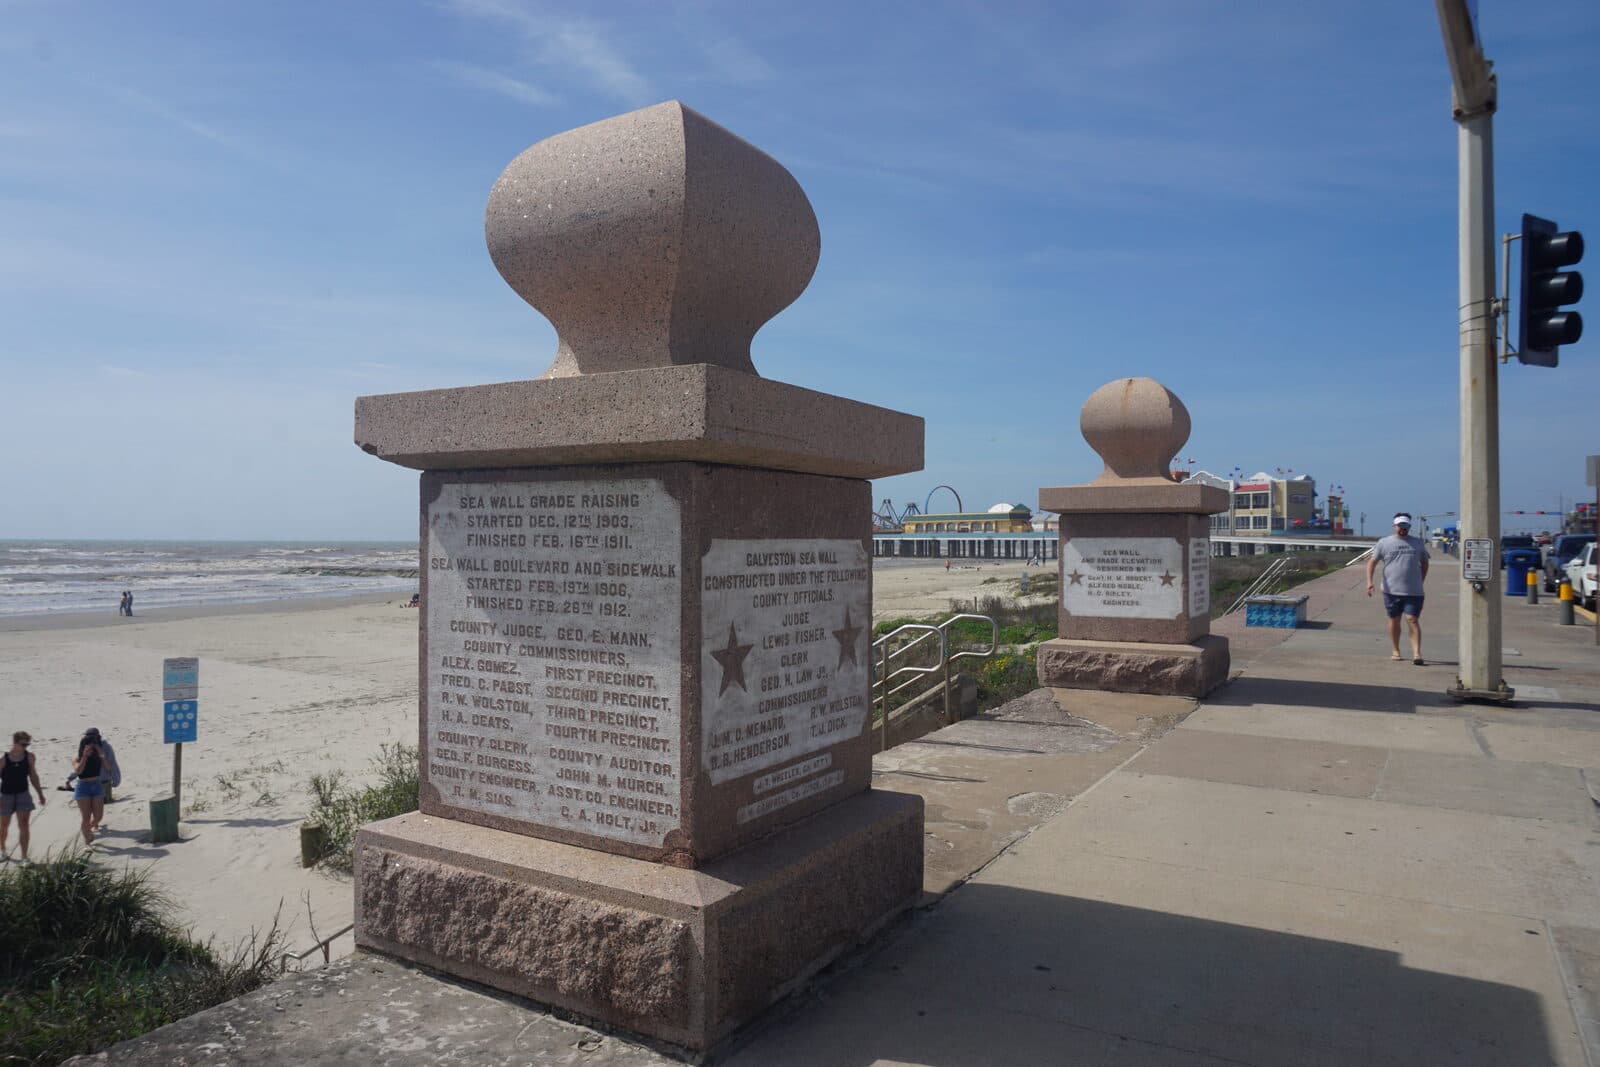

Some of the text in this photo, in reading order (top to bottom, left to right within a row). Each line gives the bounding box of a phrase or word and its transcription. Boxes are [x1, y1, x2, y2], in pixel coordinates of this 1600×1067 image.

[460, 494, 640, 510] SEA WALL GRADE RAISING
[467, 515, 523, 528] STARTED
[529, 515, 559, 528] DEC.
[596, 514, 633, 528] 1903.
[467, 534, 526, 548] FINISHED
[533, 534, 564, 548] FEB.
[604, 535, 632, 550] 1911.
[431, 558, 676, 578] SEA WALL BOULEVARD AND SIDEWALK
[746, 552, 838, 567] GALVESTON SEA WALL
[467, 578, 522, 592] STARTED
[529, 580, 560, 594] FEB.
[704, 568, 867, 591] CONSTRUCTED UNDER THE FOLLOWING
[466, 596, 523, 611] FINISHED
[529, 598, 559, 614] FEB.
[752, 592, 789, 608] COUNTY
[782, 612, 810, 626] JUDGE
[450, 620, 497, 636] COUNTY
[502, 624, 546, 640] JUDGE,
[557, 628, 588, 644] GEO.
[592, 630, 605, 644] E.
[464, 640, 512, 657] COUNTY
[762, 633, 790, 650] LEWIS
[780, 651, 808, 668] CLERK
[441, 656, 474, 670] ALEX.
[545, 666, 584, 681] FIRST
[587, 670, 657, 689] PRECINCT.
[760, 676, 782, 692] GEO.
[796, 668, 813, 684] LAW
[441, 674, 474, 689] FRED.
[478, 678, 490, 691] C.
[546, 685, 598, 702] SECOND
[602, 692, 672, 712] PRECINCT.
[758, 686, 828, 714] COMMISSIONERS
[442, 692, 452, 704] R.
[456, 693, 468, 706] W.
[472, 695, 534, 718] WOLSTON,
[546, 704, 586, 722] THIRD
[438, 730, 485, 748] COUNTY
[442, 710, 670, 753] H. A. DEATS, FOURTH PRECINCT.
[724, 730, 733, 745] M.
[436, 748, 460, 761] GEO.
[549, 748, 676, 779] COUNTY AUDITOR,
[431, 764, 540, 794] COUNTY ENGINEER,
[556, 768, 590, 784] JOHN
[597, 774, 612, 788] M.
[454, 785, 464, 798] R.
[547, 784, 678, 818] ASST. CO. ENGINEER,
[561, 806, 573, 818] C.
[580, 808, 592, 822] A.
